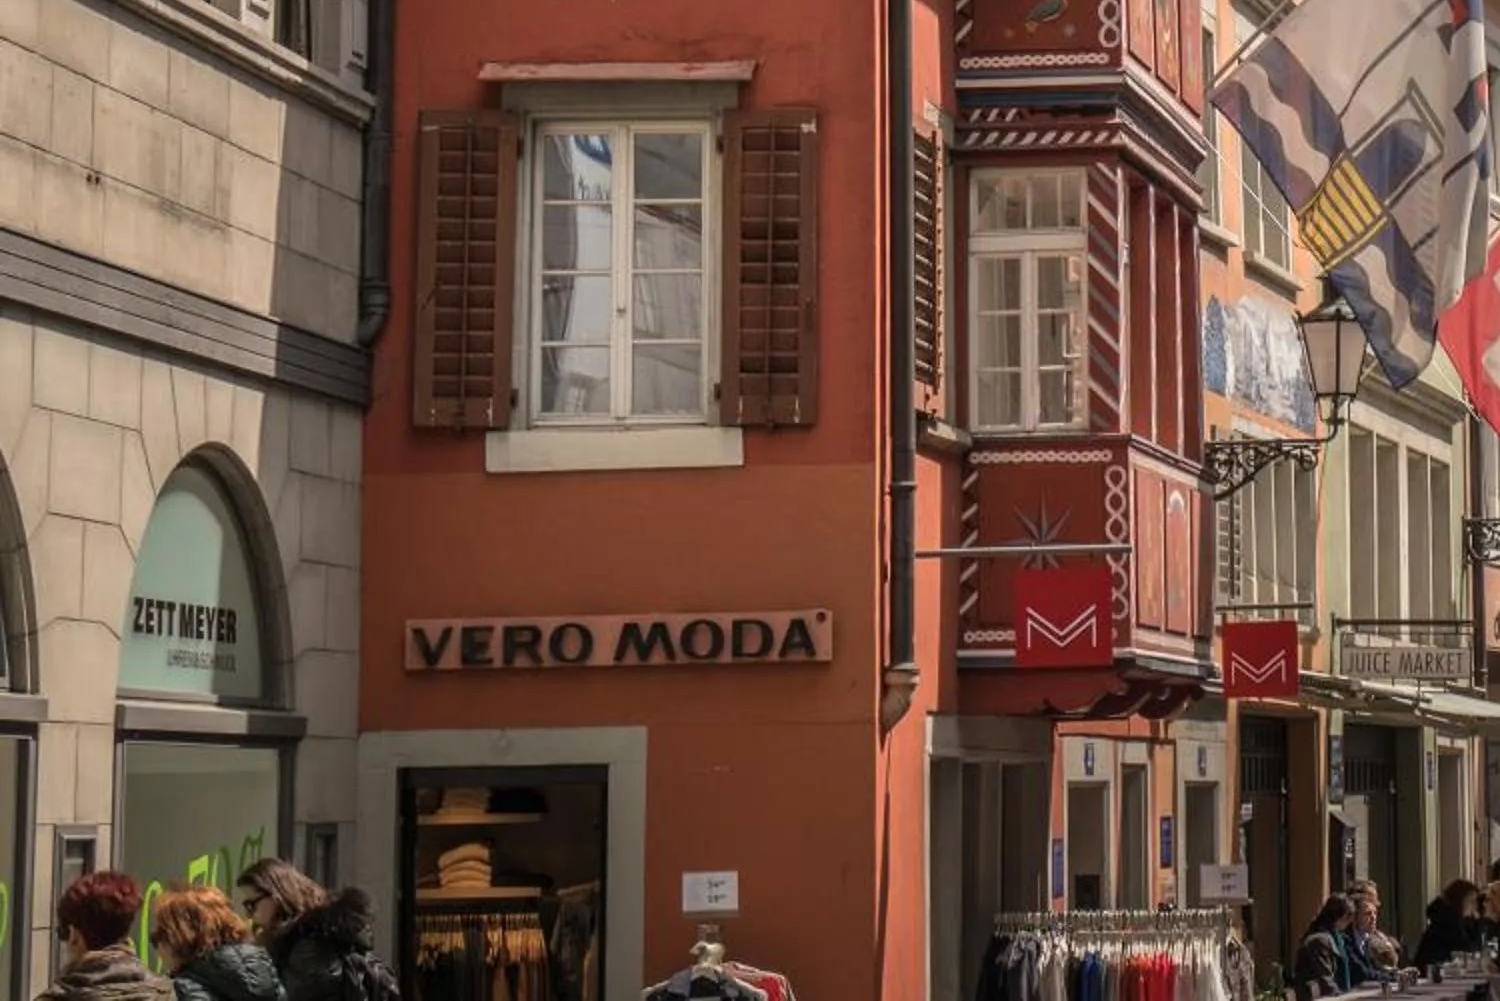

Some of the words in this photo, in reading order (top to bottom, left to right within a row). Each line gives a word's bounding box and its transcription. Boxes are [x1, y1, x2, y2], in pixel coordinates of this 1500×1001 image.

[133, 597, 177, 636] ZETT
[179, 602, 237, 644] MEYER
[411, 622, 595, 667] VERO
[612, 618, 818, 663] MODA
[1348, 651, 1391, 675] JUICE
[1400, 652, 1464, 674] MARKET
